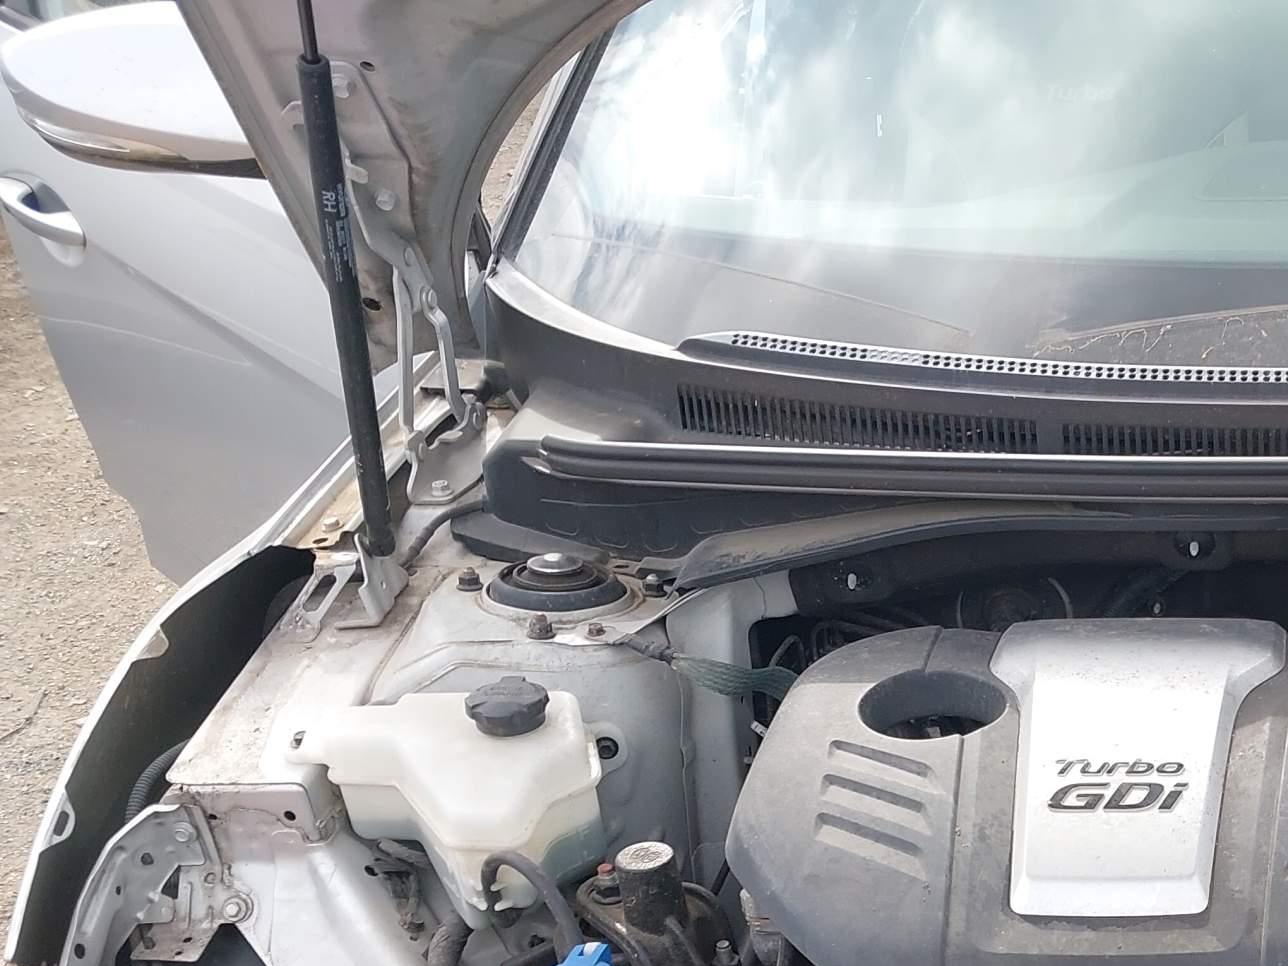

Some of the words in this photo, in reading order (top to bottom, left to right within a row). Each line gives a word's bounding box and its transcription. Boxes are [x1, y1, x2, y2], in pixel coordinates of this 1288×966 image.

[321, 190, 337, 213] RH
[1056, 757, 1185, 777] Turbo
[1047, 781, 1190, 814] GDi
